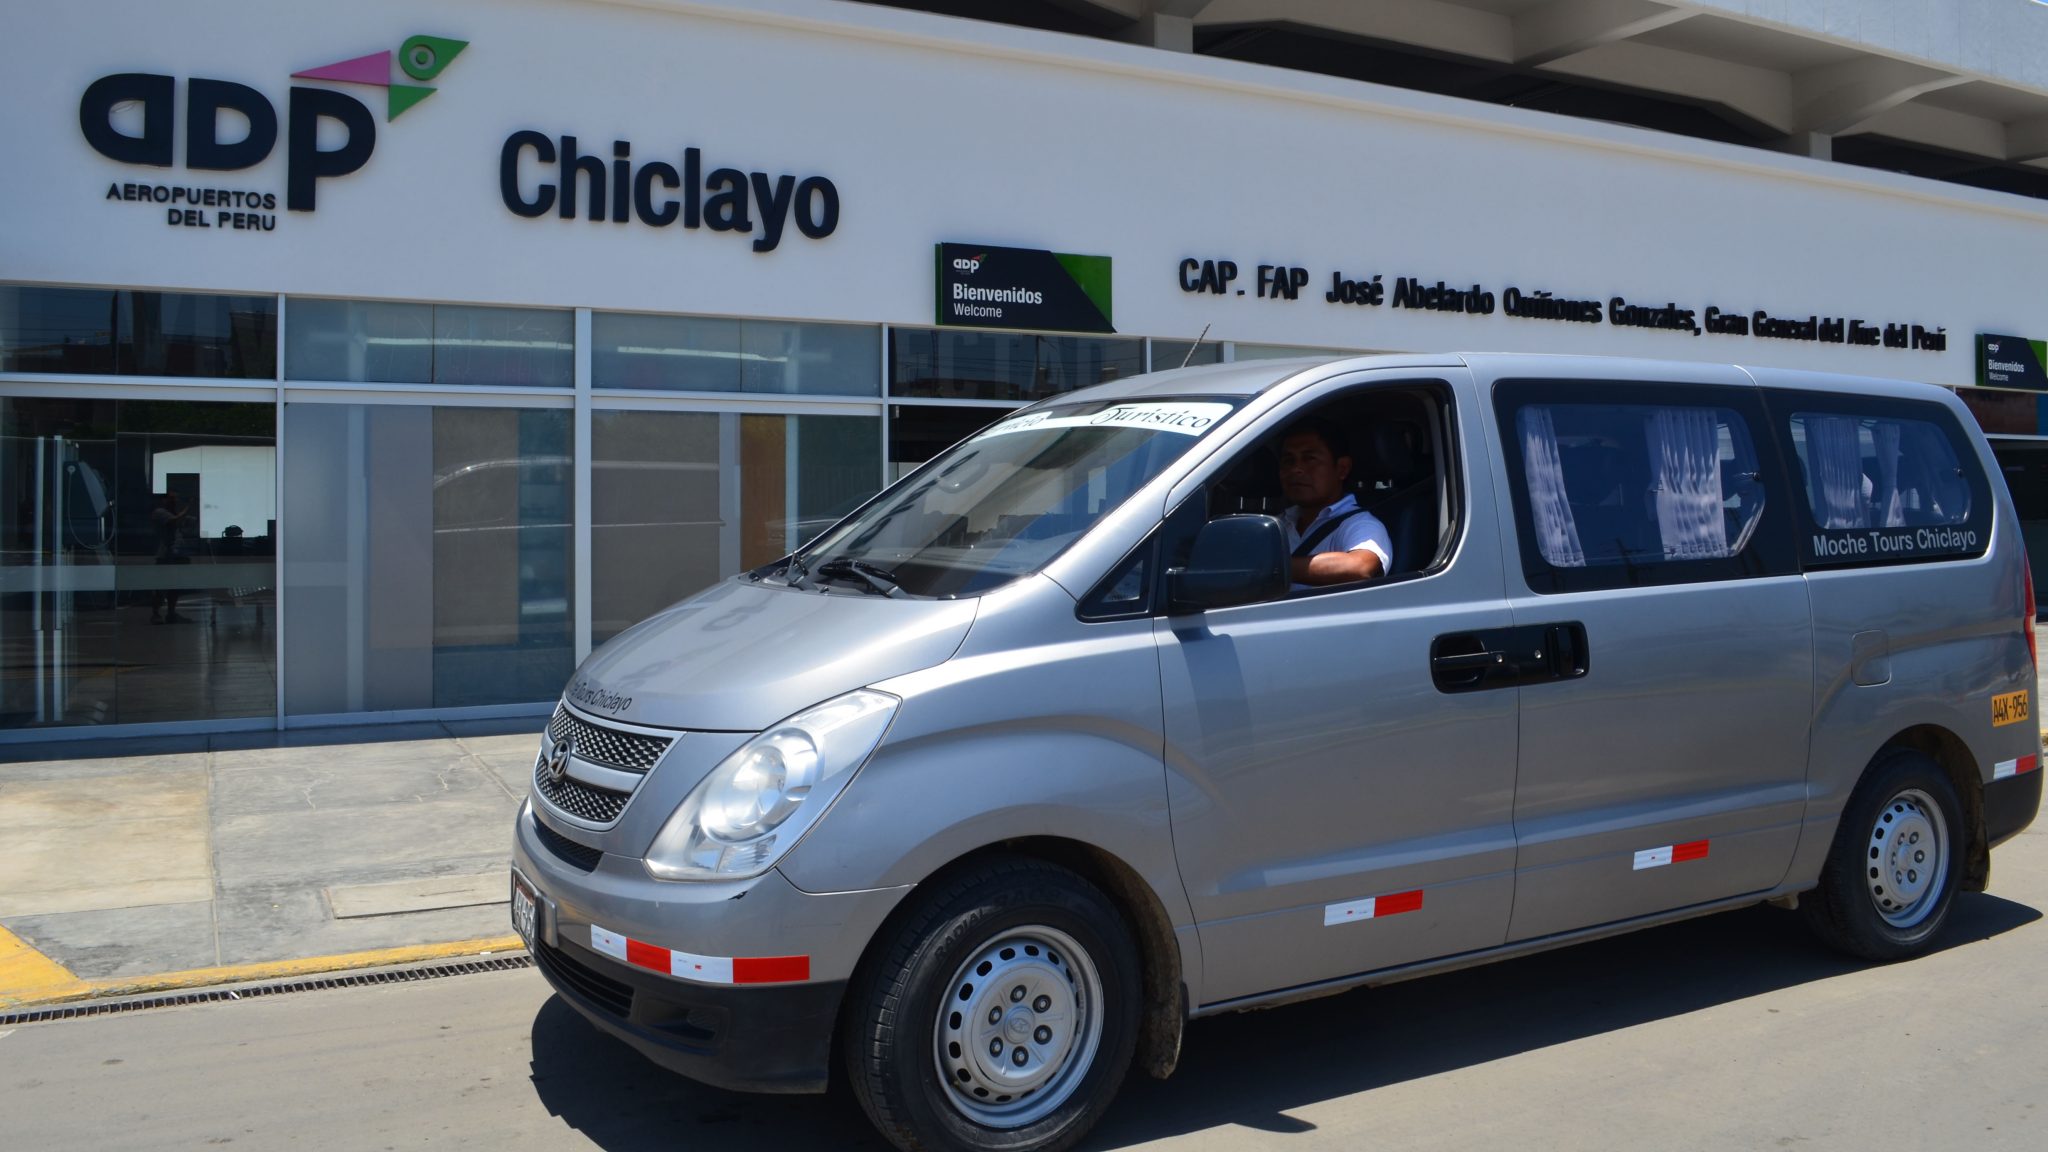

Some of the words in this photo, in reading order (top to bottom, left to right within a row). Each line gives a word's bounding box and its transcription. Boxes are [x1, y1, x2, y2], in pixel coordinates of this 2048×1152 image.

[106, 183, 276, 211] AEROPUERTOS
[500, 130, 840, 252] Chiclayo
[168, 208, 210, 228] DEL
[218, 211, 276, 232] PERU
[953, 283, 1042, 304] Bienvenidos
[1179, 258, 1245, 296] CAP.
[1257, 264, 1309, 300] FAP
[1326, 270, 1384, 305] José
[1392, 277, 1495, 315] Abelardo
[953, 303, 1003, 318] Welcome
[1988, 359, 2025, 373] Bienvenidos
[1813, 534, 1867, 557] Moche
[1869, 531, 1914, 553] Tours
[1916, 527, 1977, 551] Chiclayo
[591, 689, 632, 714] Chiclayo
[1993, 693, 2027, 722] A4X-956
